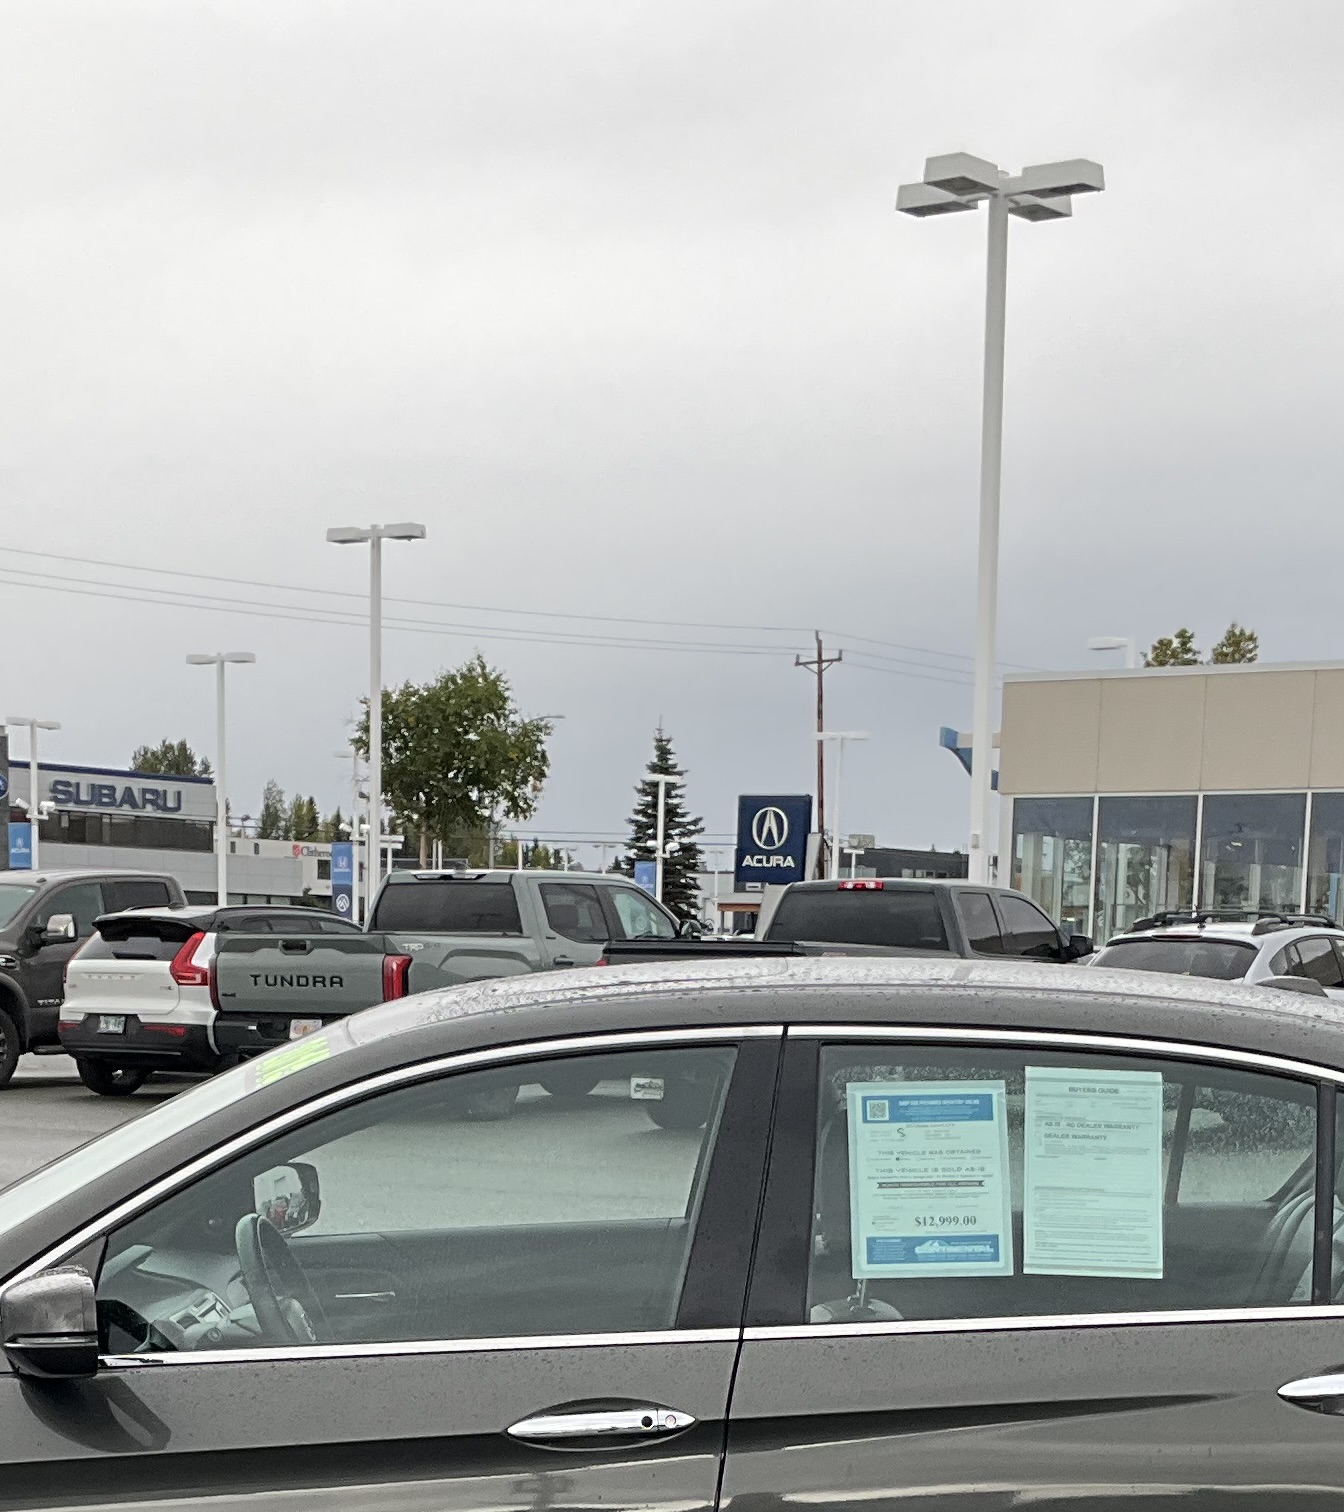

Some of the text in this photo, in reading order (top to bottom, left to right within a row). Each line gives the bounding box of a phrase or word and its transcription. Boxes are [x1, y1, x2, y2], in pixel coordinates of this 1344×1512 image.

[49, 779, 182, 813] SUBARU
[742, 855, 795, 868] ACURA
[249, 974, 344, 988] TUNDRA
[914, 1215, 977, 1228] $12,999.00
